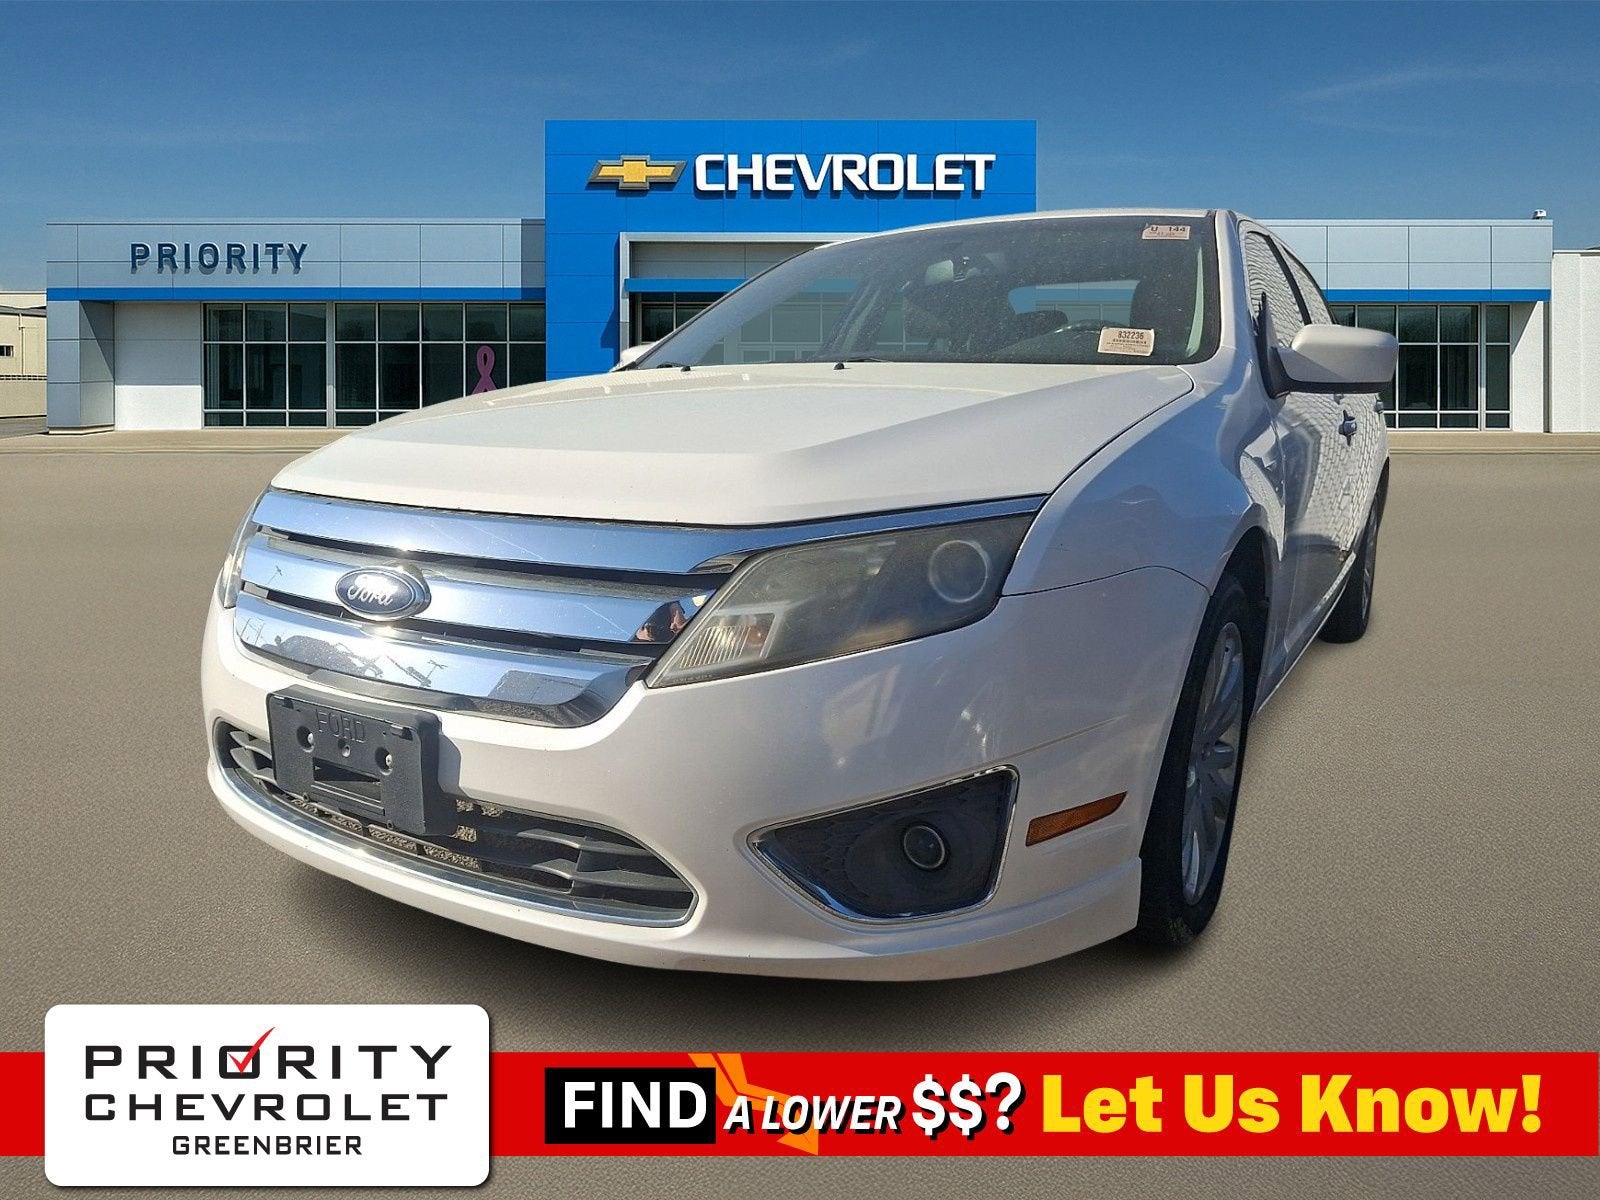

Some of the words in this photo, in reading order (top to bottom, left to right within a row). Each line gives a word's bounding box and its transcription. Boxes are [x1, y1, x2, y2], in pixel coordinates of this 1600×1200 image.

[696, 154, 996, 192] CHEVROLET
[130, 243, 308, 270] PRIORITY
[346, 573, 399, 606] Ford
[316, 709, 366, 743] FORD
